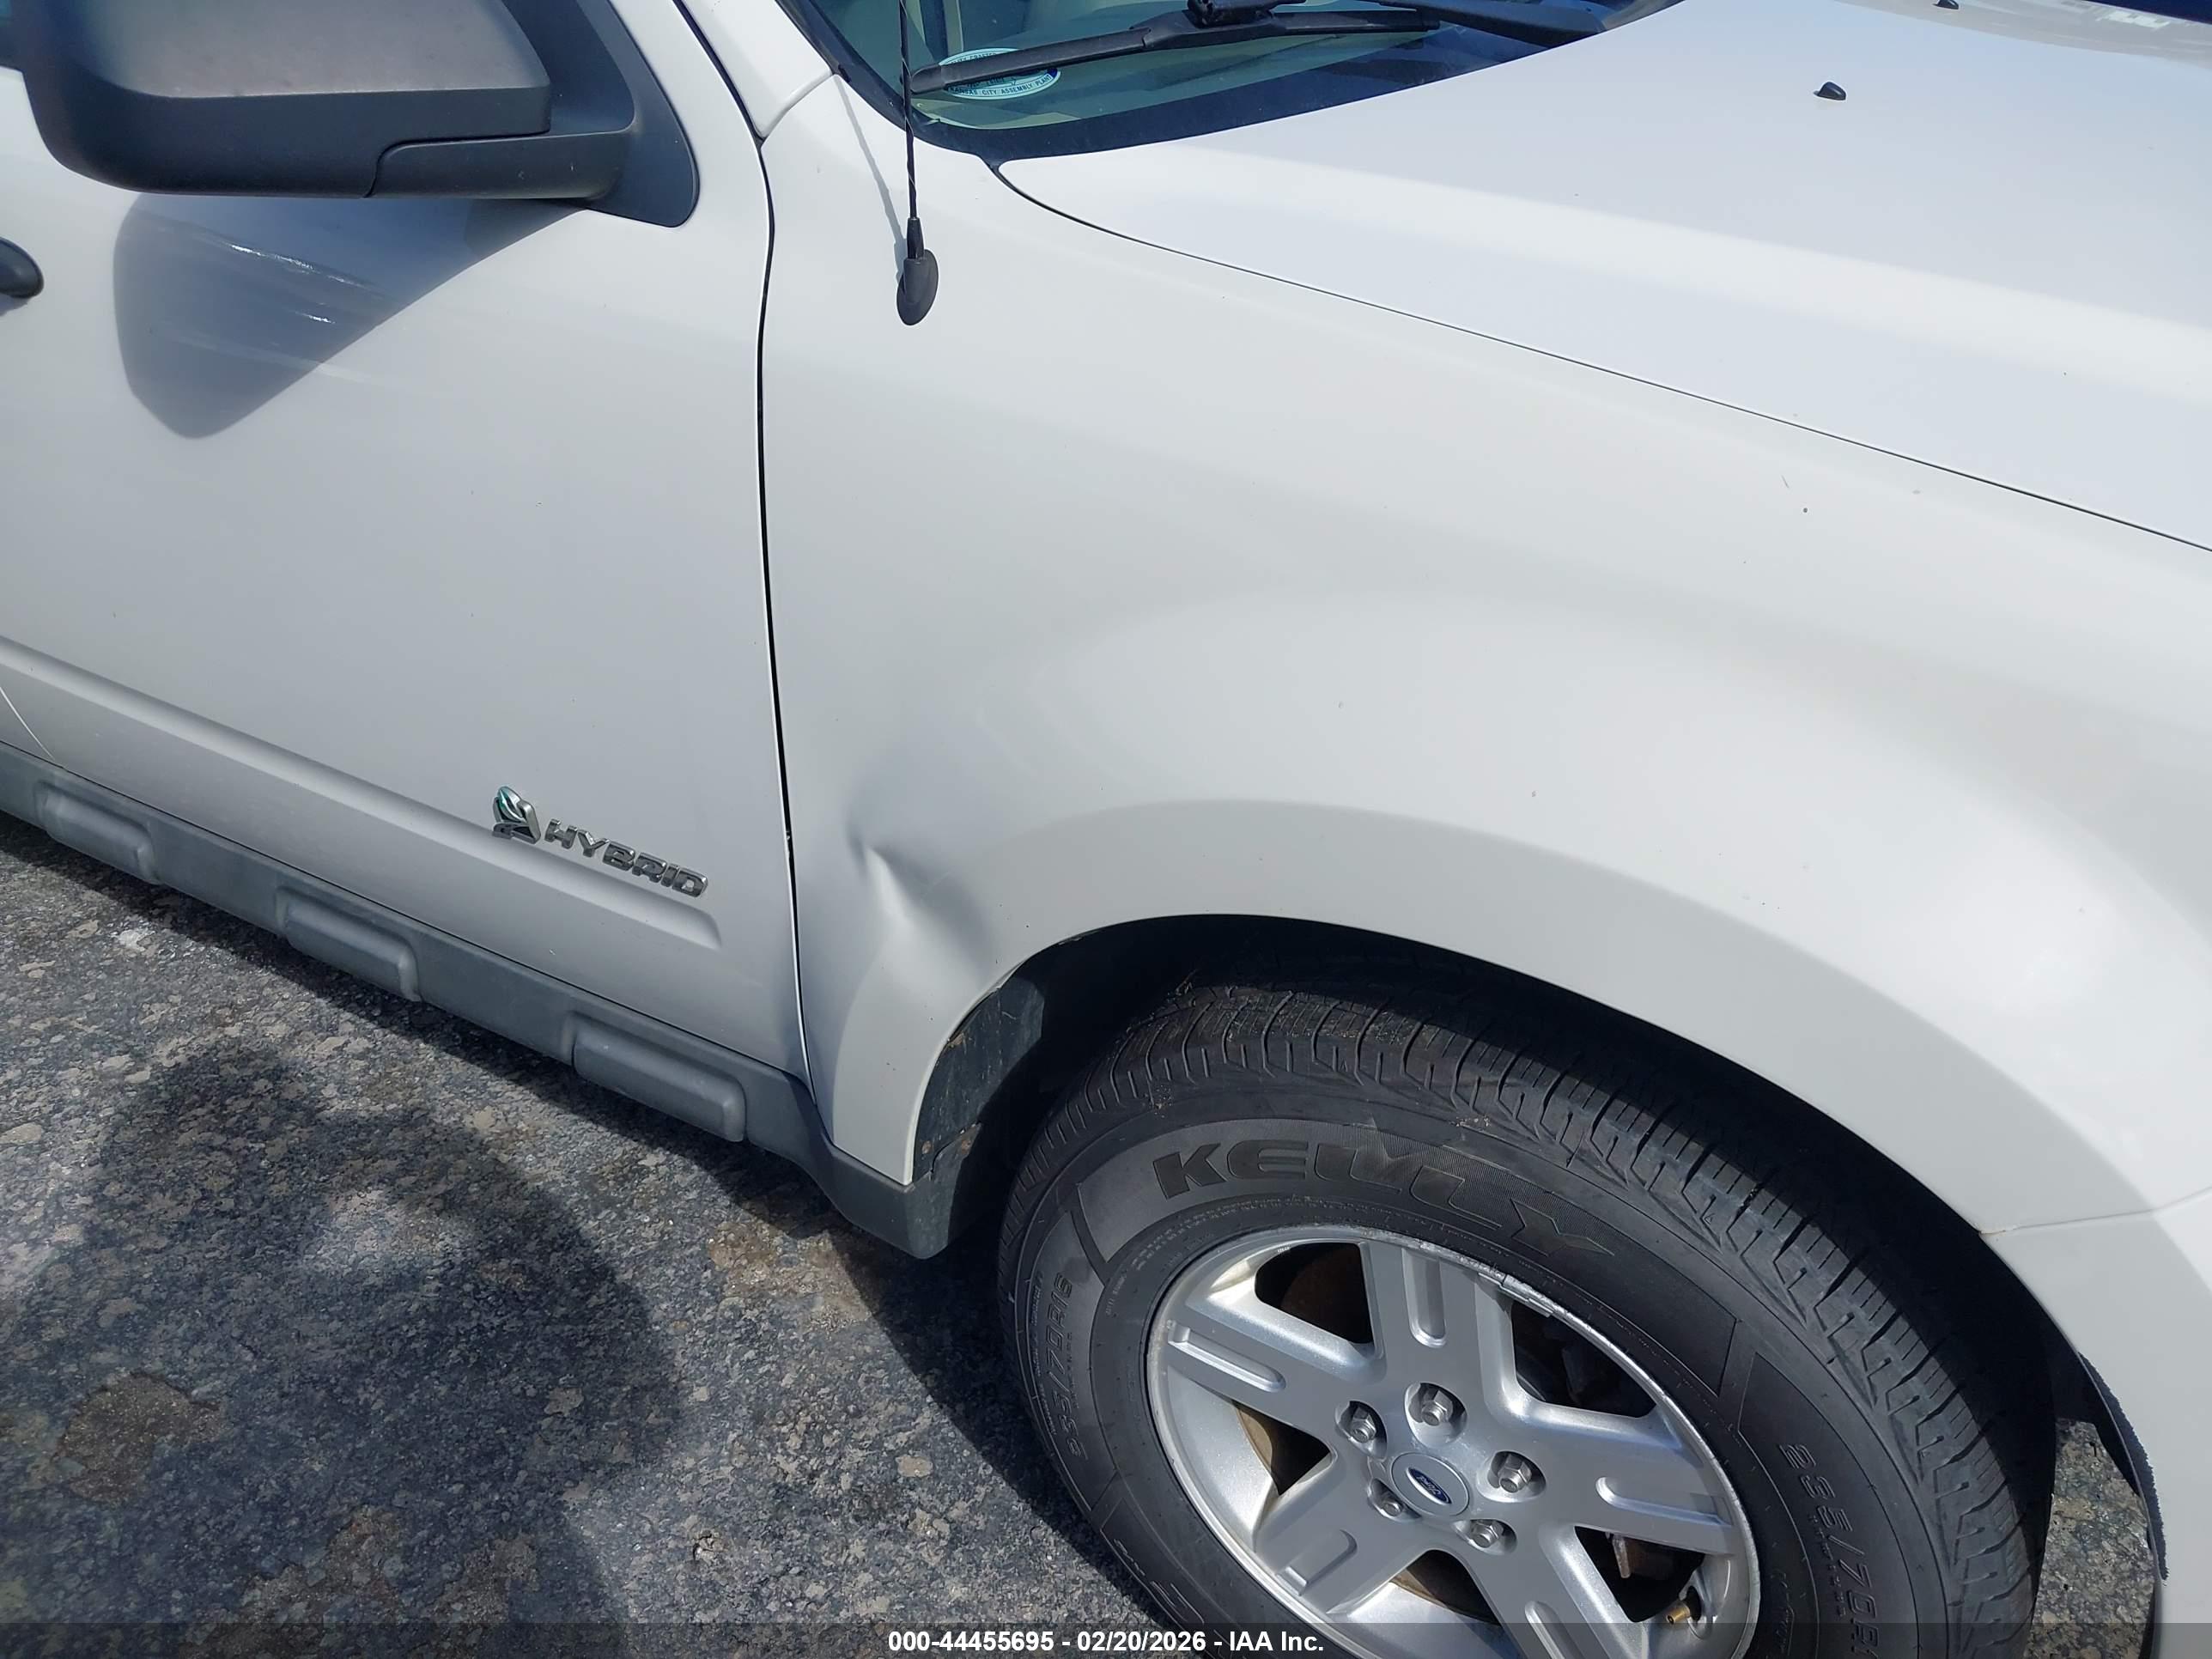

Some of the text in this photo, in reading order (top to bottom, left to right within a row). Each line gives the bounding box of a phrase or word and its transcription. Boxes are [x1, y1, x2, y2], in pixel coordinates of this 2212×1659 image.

[950, 85, 978, 96] KANSAS
[1001, 83, 1033, 94] ASSEMBLY
[1035, 74, 1053, 89] PLANT
[544, 817, 708, 898] HYBRID
[1152, 1139, 1615, 1257] KELLY
